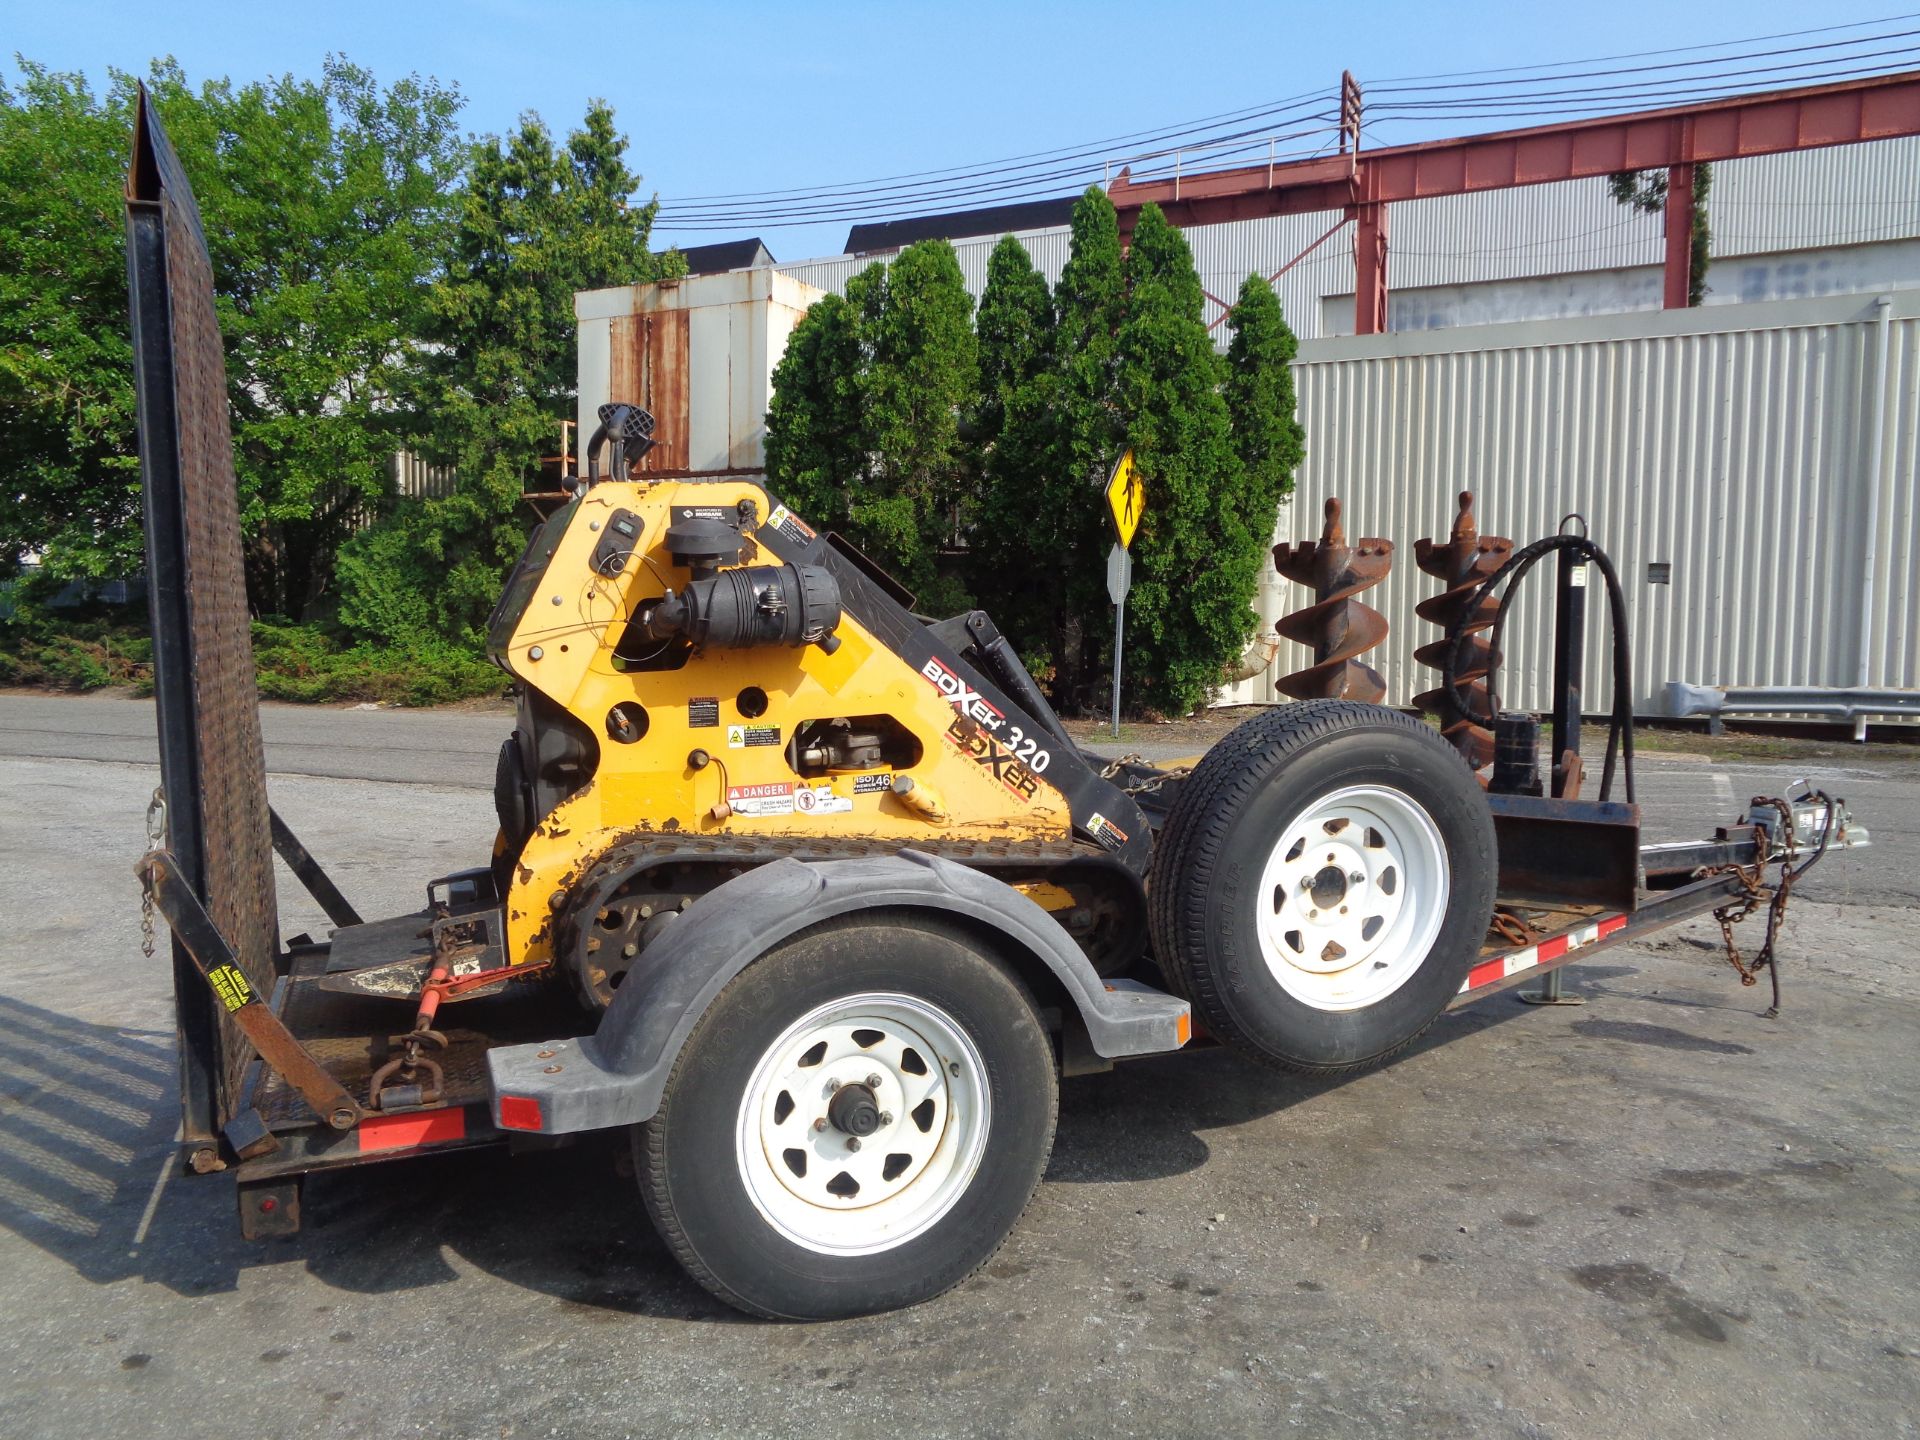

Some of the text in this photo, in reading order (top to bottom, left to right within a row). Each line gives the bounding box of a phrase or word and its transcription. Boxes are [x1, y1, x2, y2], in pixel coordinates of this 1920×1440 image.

[922, 660, 1050, 773] BOXER 320
[876, 774, 890, 786] 46
[743, 784, 787, 798] DANGER!
[232, 969, 251, 994] CAUTION
